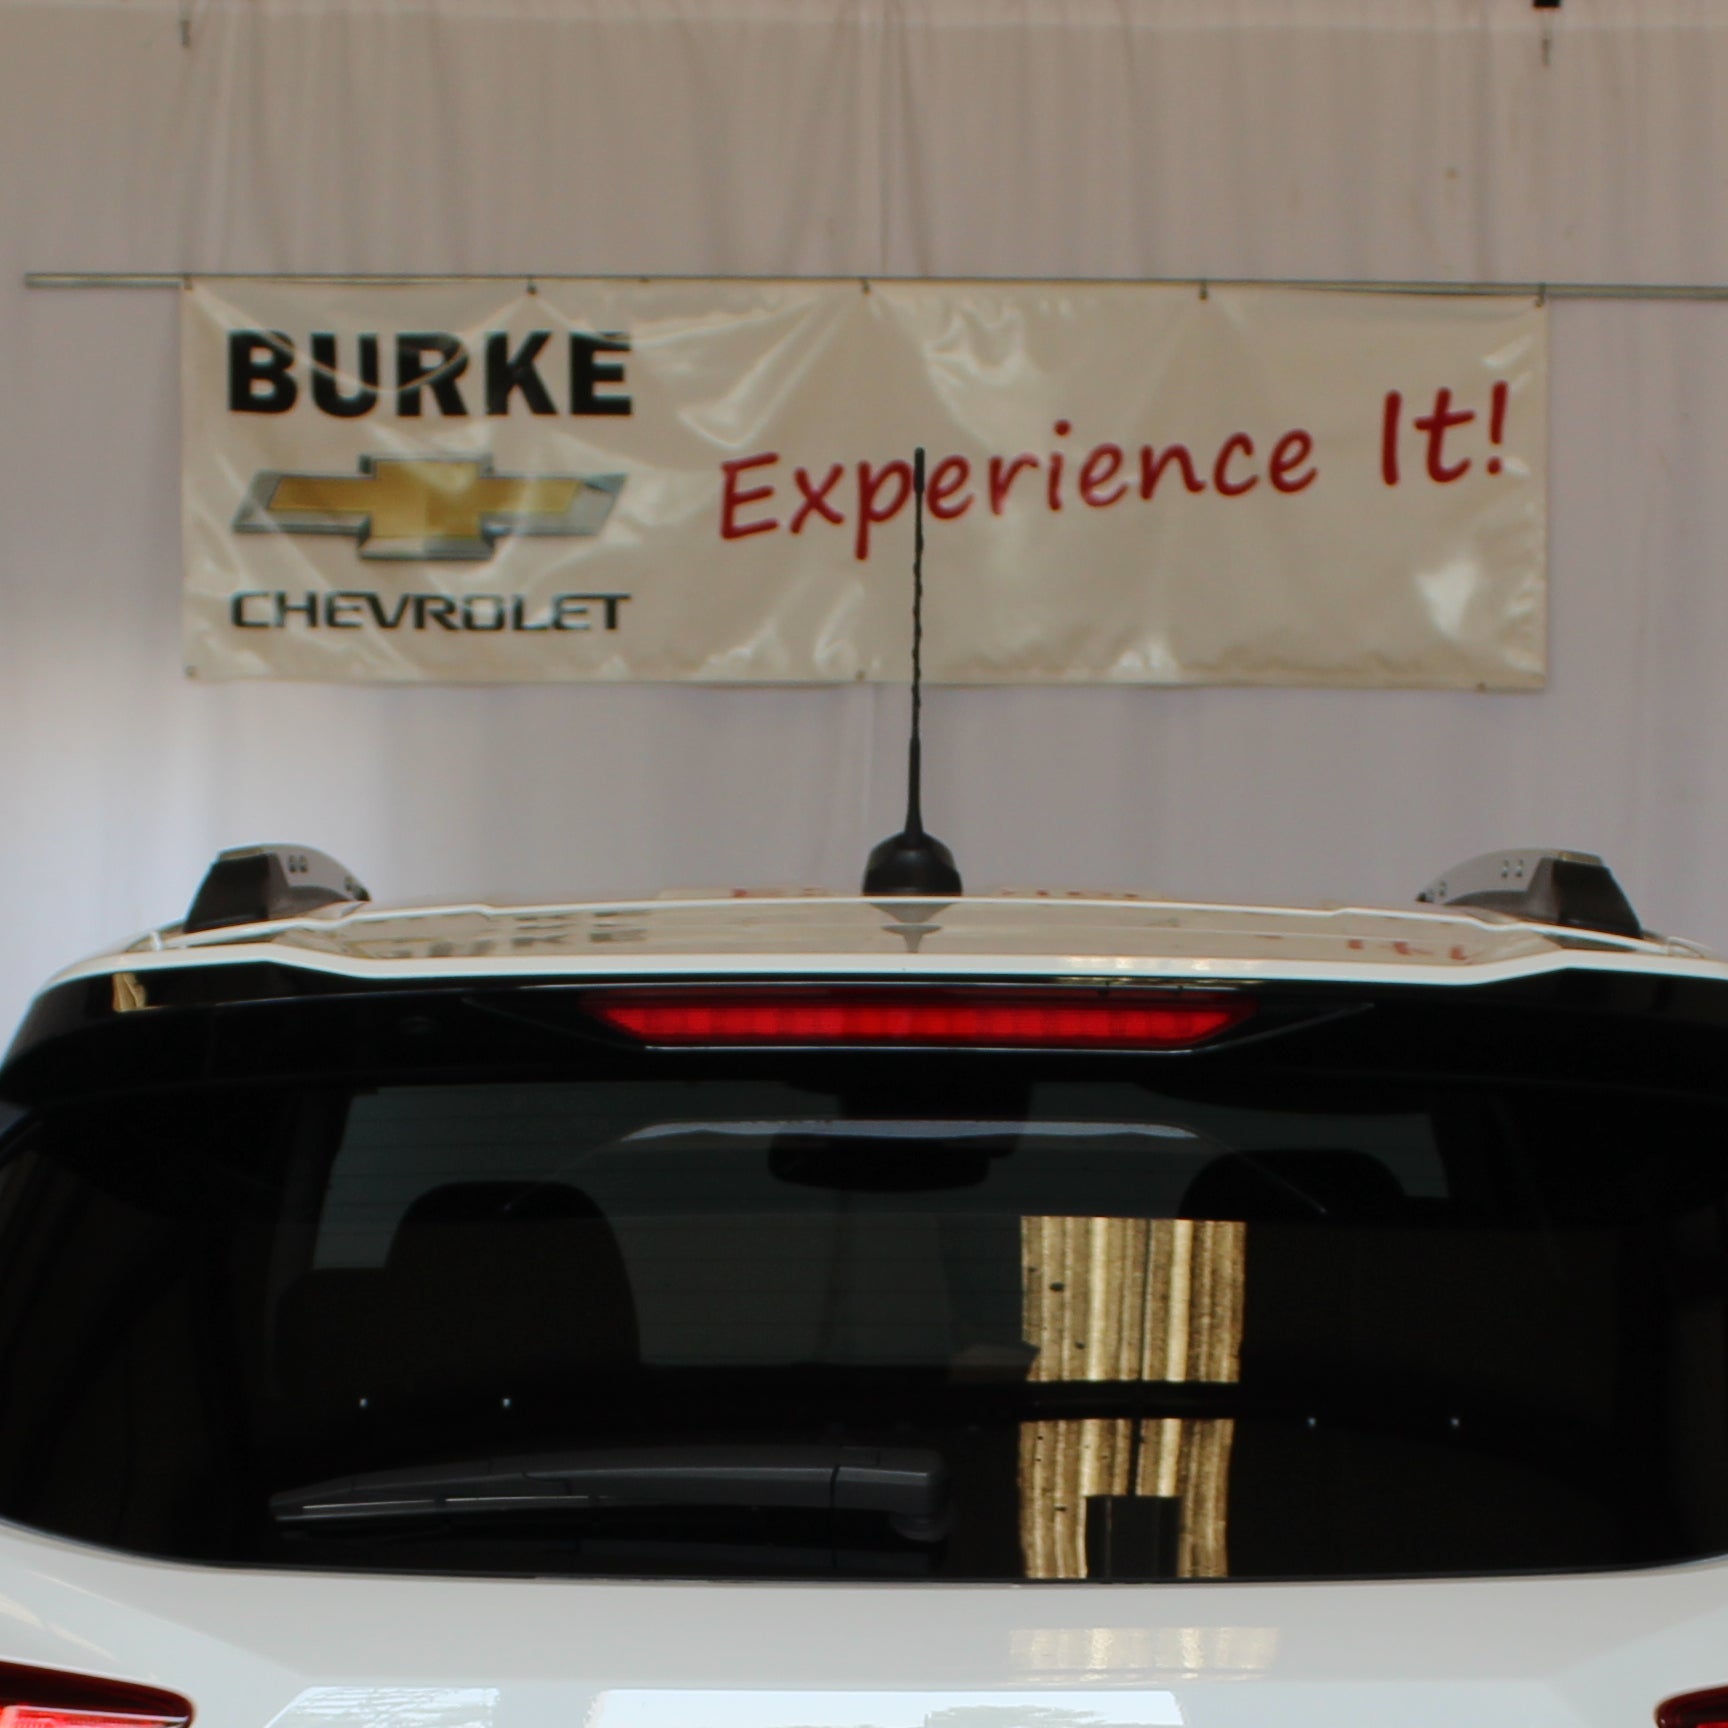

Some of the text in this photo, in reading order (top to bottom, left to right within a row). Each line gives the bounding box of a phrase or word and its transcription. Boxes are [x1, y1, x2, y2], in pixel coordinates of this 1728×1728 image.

[228, 329, 634, 418] BURKE
[719, 381, 1510, 561] Experience It!
[230, 590, 633, 631] CHEVROLET
